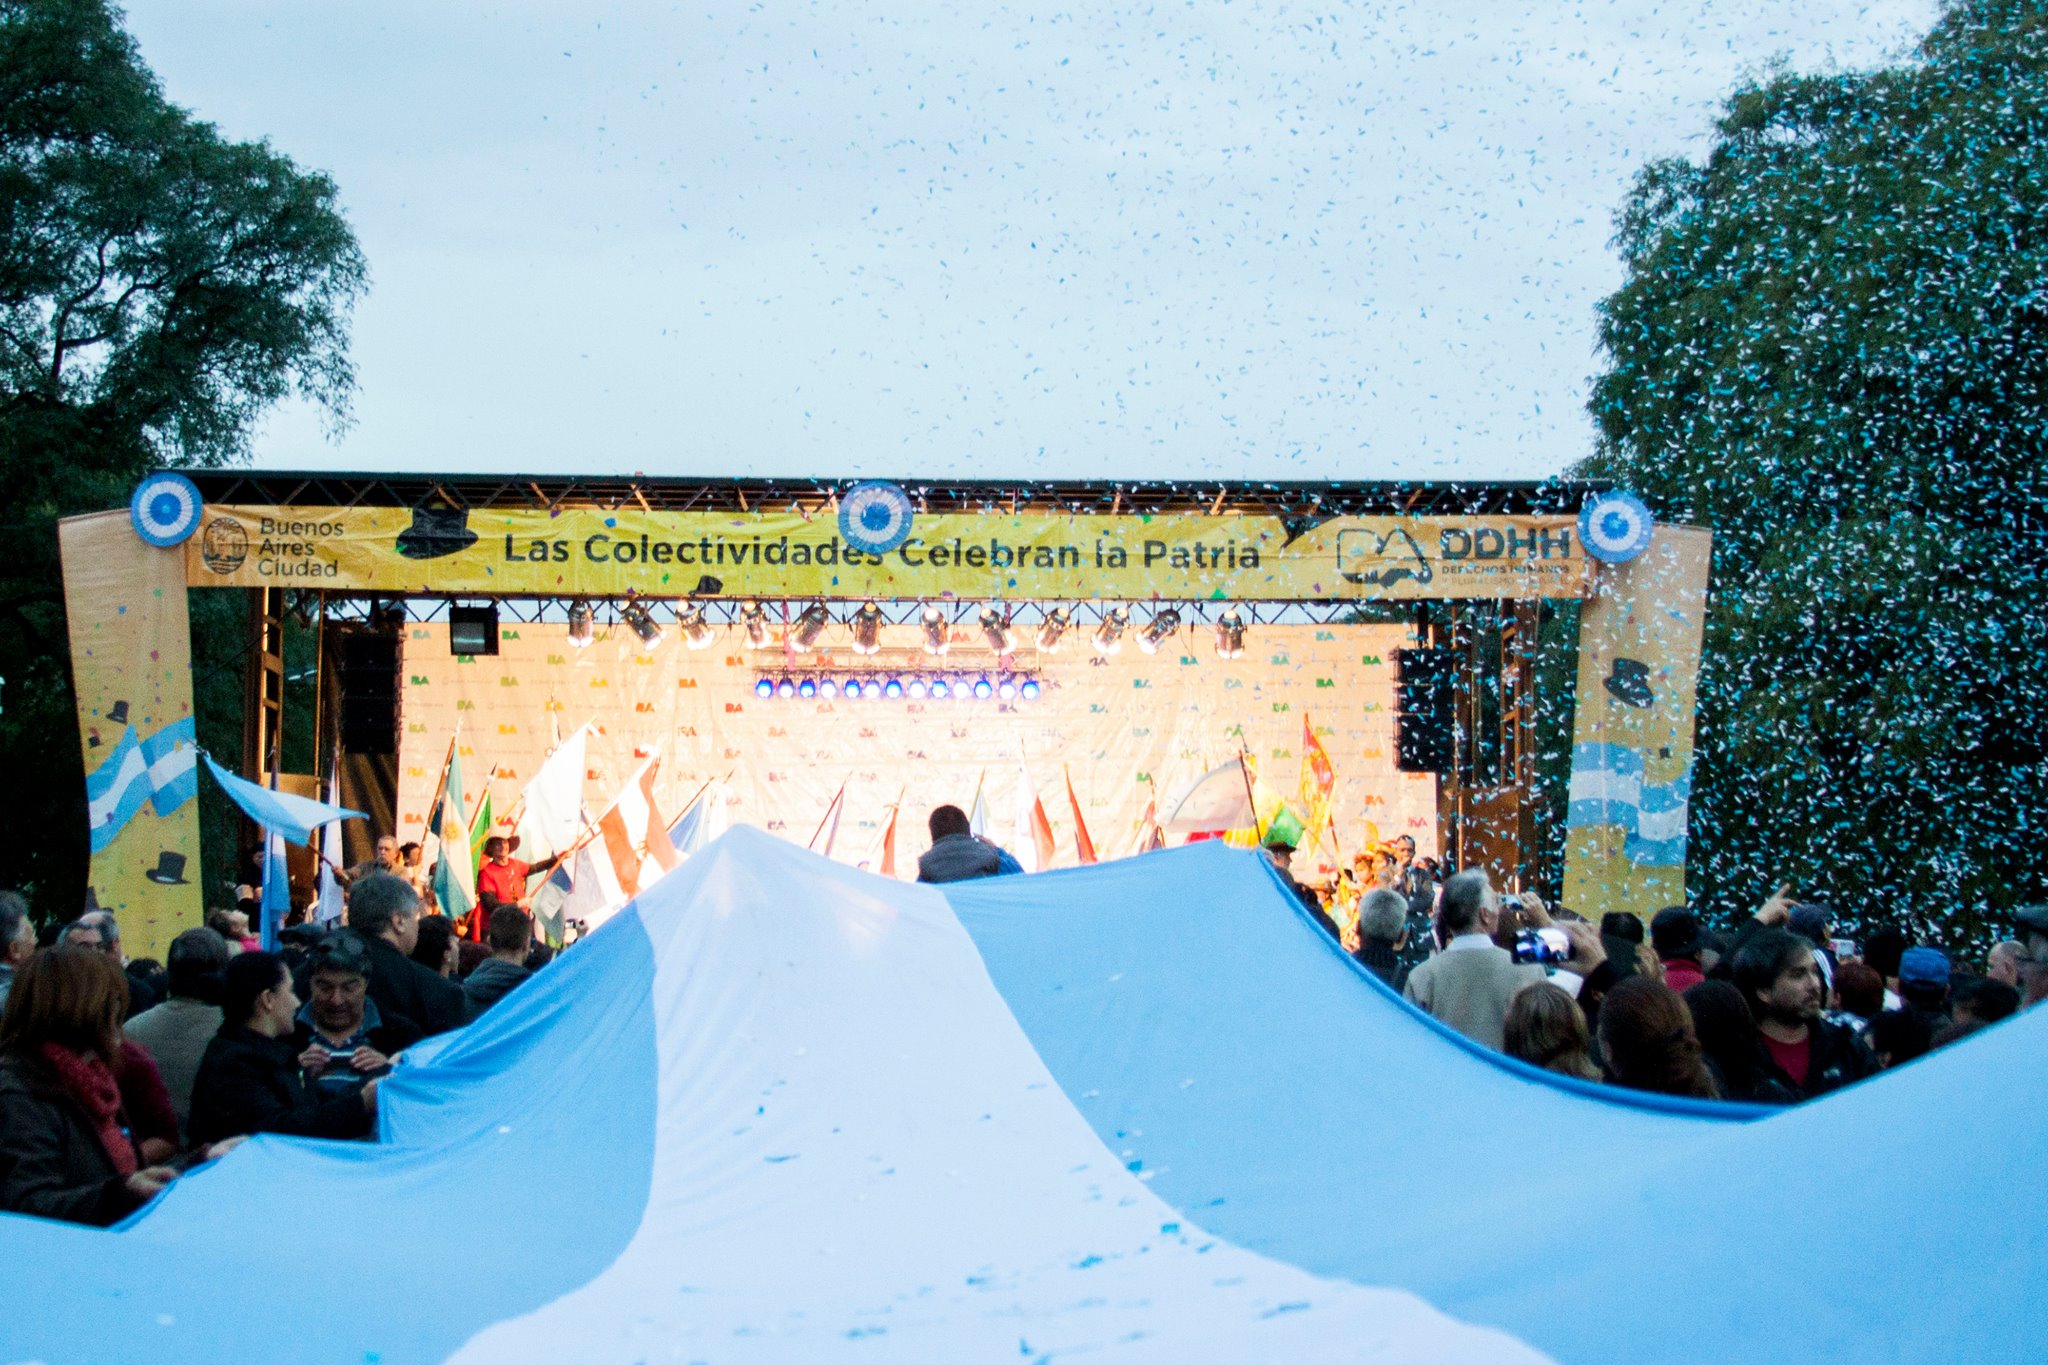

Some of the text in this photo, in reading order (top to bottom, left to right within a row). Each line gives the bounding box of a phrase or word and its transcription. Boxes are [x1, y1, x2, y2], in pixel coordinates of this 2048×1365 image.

[260, 517, 344, 536] Buenos
[259, 538, 315, 557] Aires
[505, 534, 569, 562] Las
[899, 538, 1079, 568] Celebran
[1096, 539, 1127, 568] la
[1144, 540, 1259, 569] Patria
[1441, 528, 1570, 560] DDHH
[258, 560, 338, 577] Ciudad
